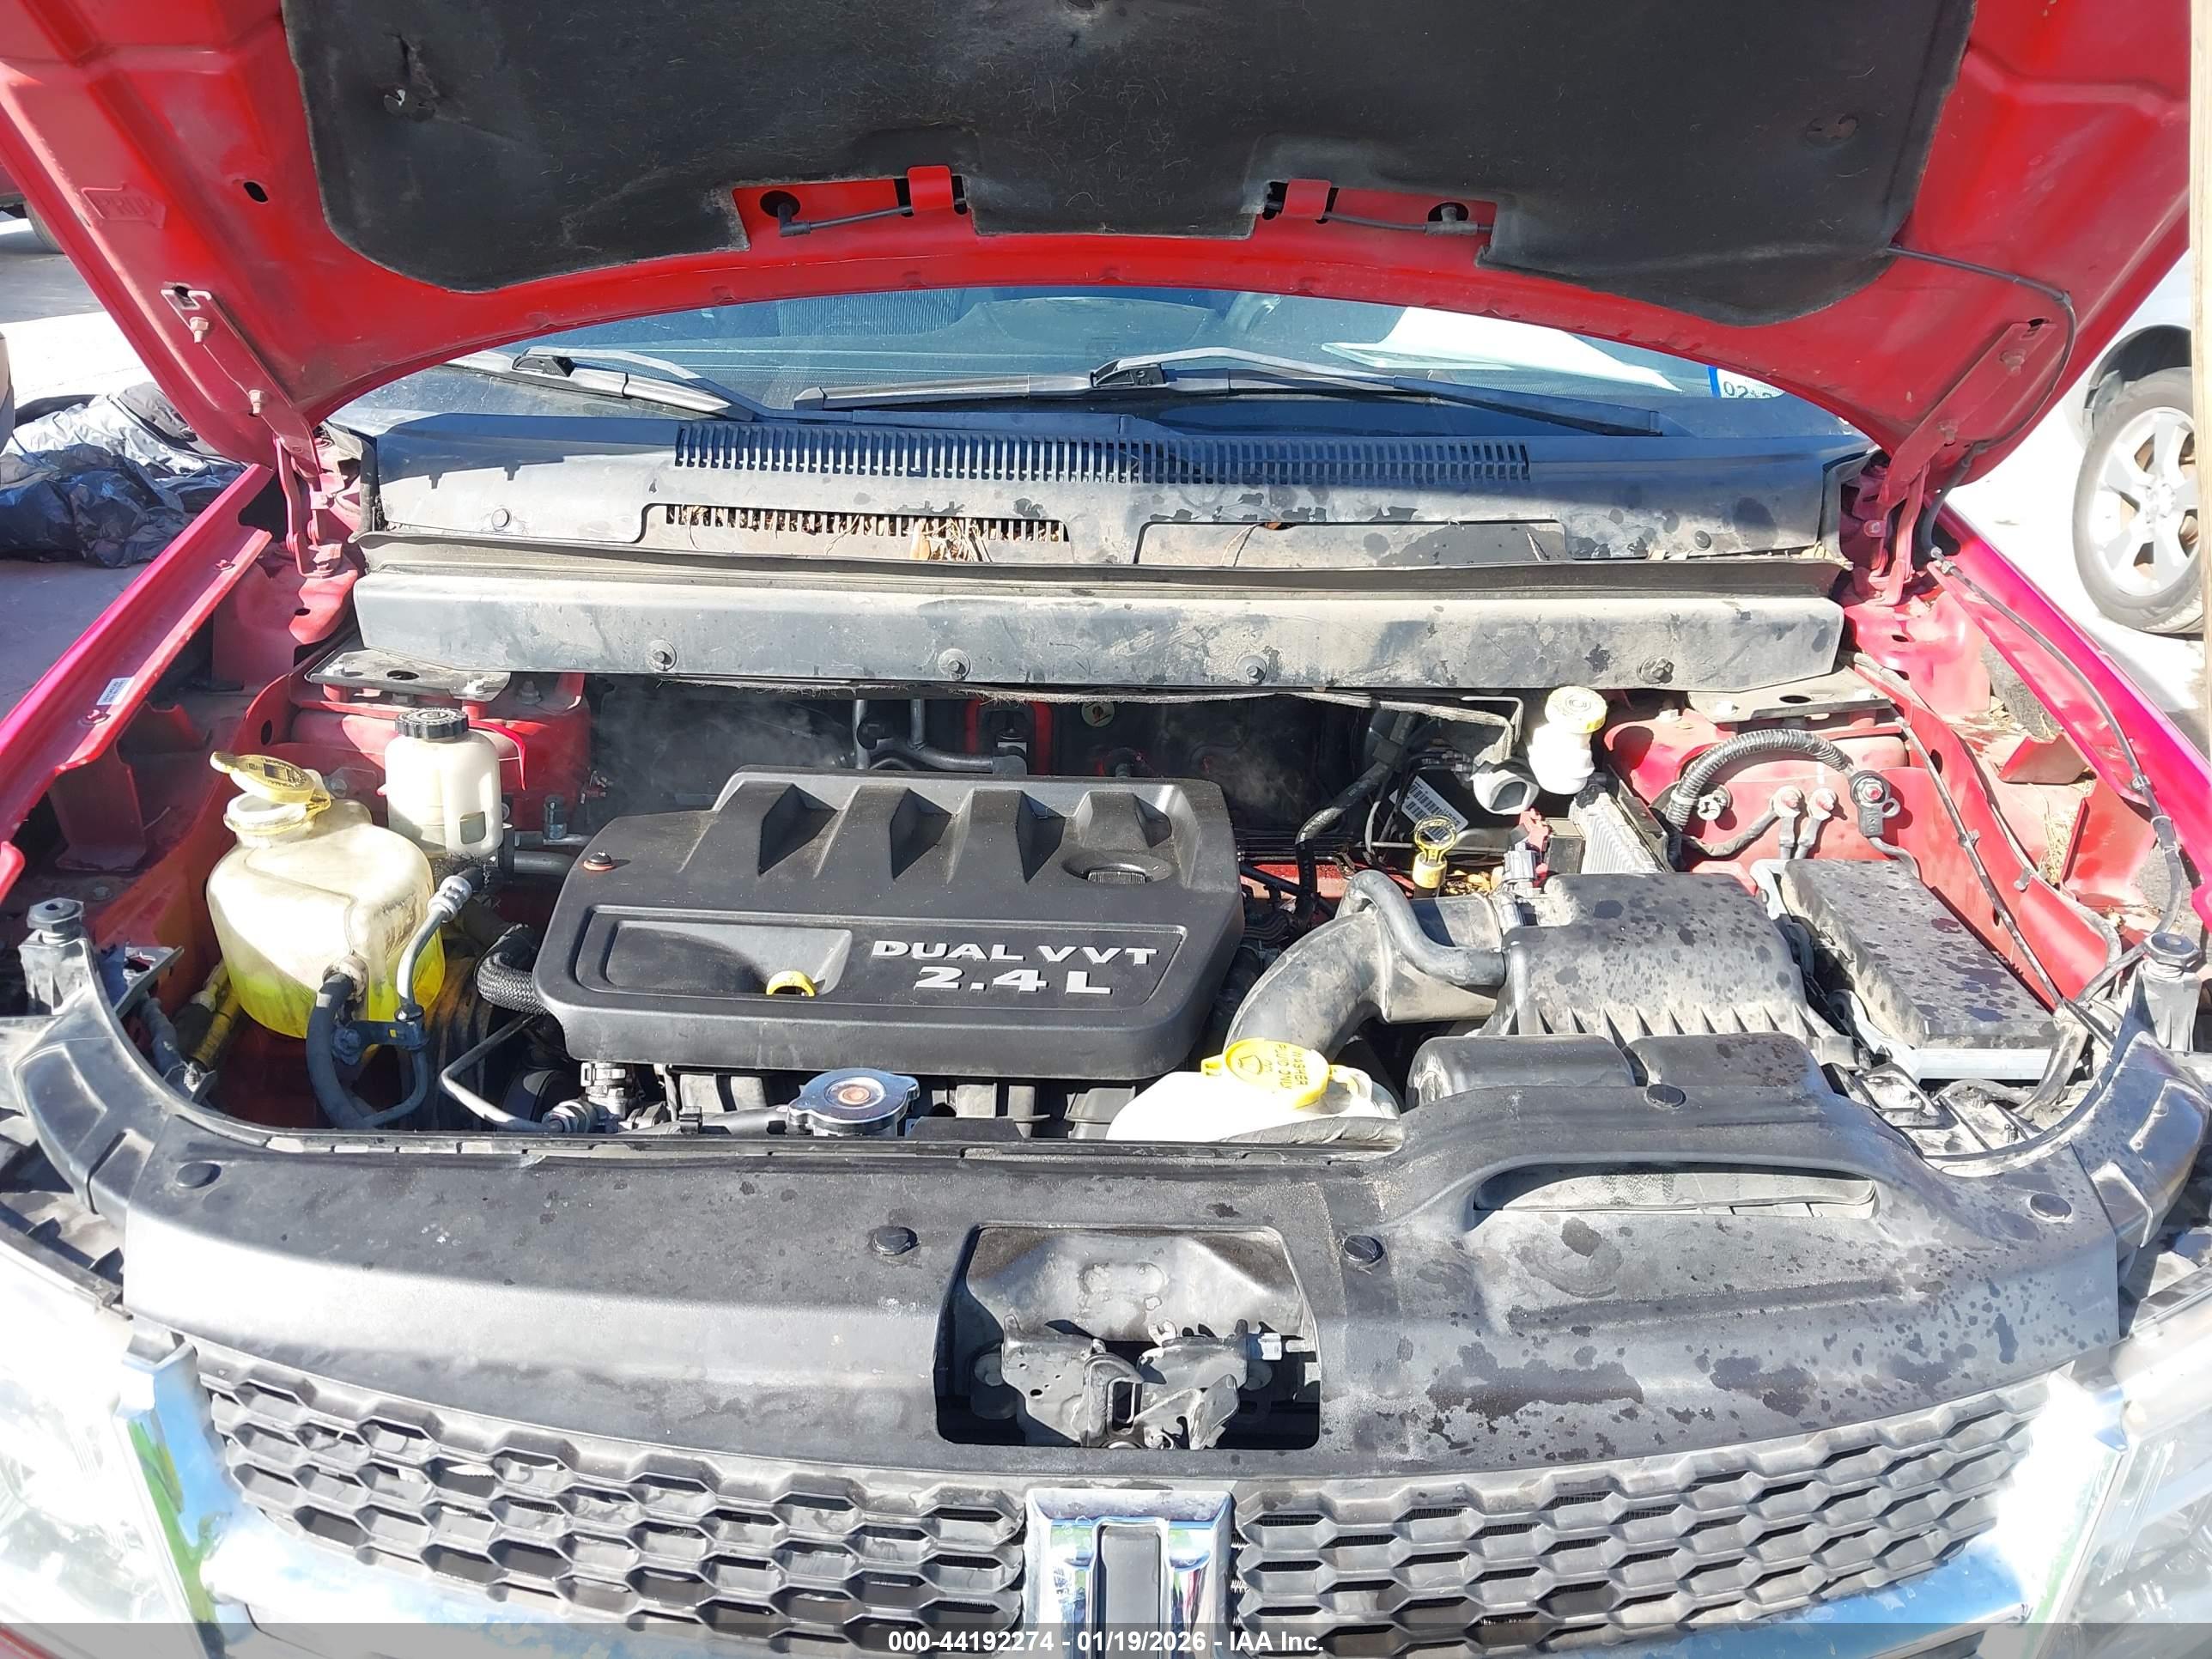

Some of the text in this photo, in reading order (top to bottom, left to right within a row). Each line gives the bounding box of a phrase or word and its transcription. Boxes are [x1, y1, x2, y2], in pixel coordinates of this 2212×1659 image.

[871, 940, 1158, 965] DUAL VVT
[1292, 1053, 1308, 1085] WASHER
